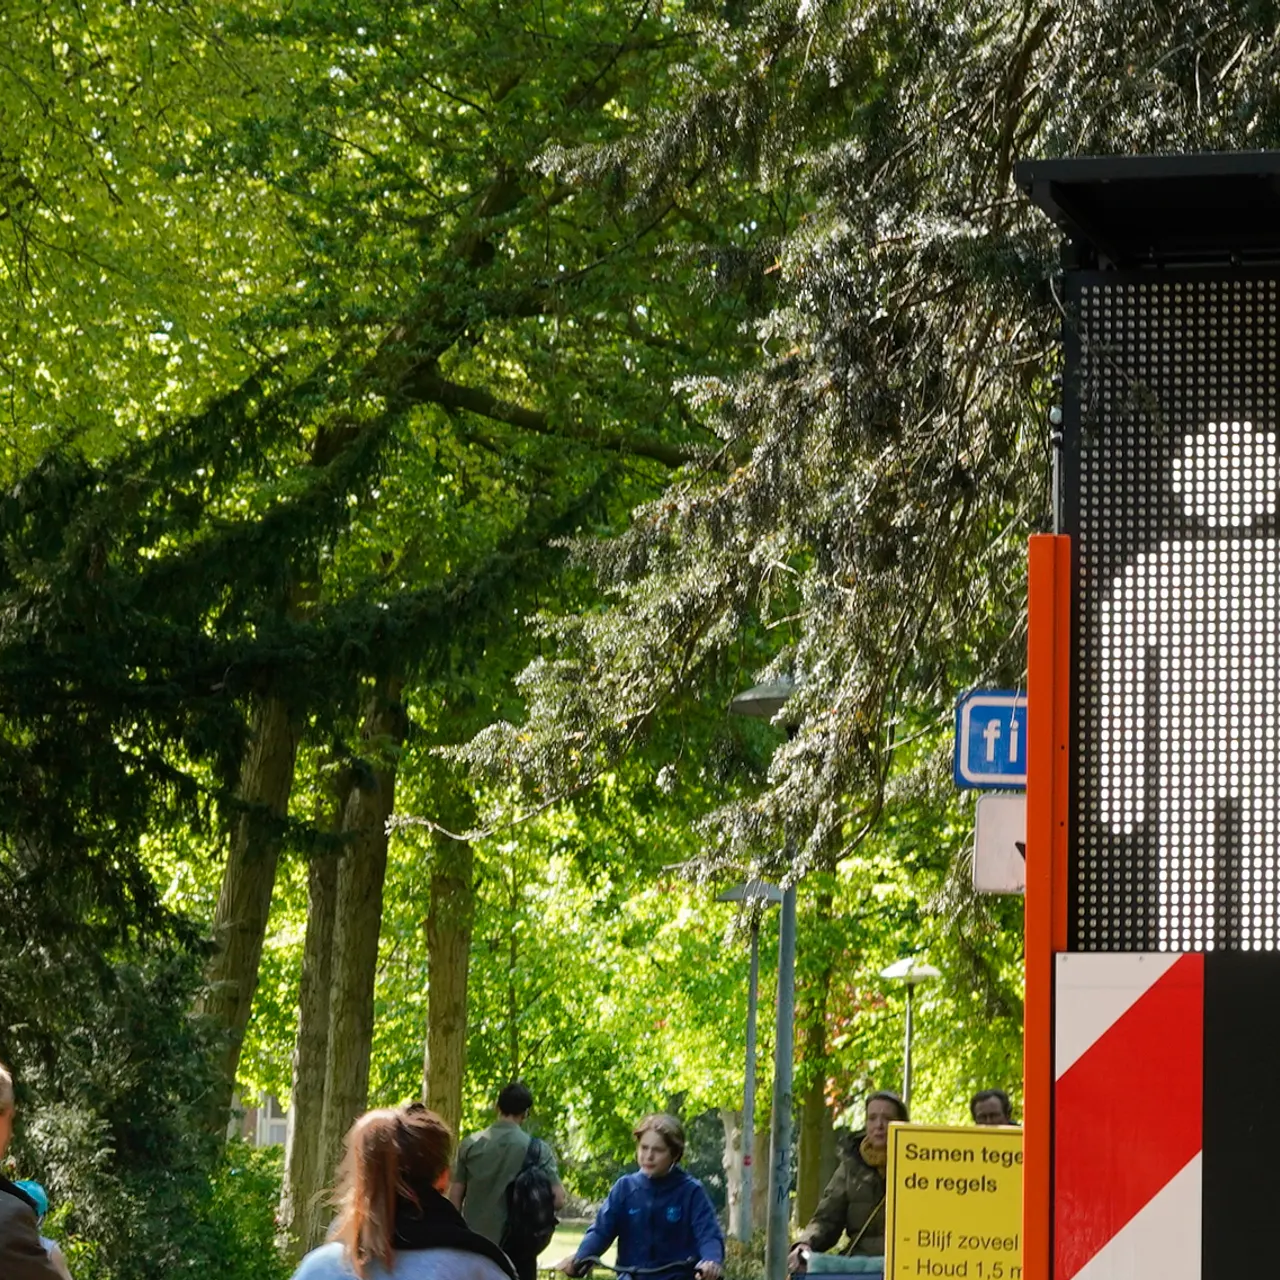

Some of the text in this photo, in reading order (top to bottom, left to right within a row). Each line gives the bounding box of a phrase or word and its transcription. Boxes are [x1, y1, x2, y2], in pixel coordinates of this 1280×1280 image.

[905, 1143, 974, 1162] Samen
[904, 1172, 997, 1195] de regels
[917, 1229, 1019, 1252] Blijf zoveel
[916, 1258, 968, 1277] Houd
